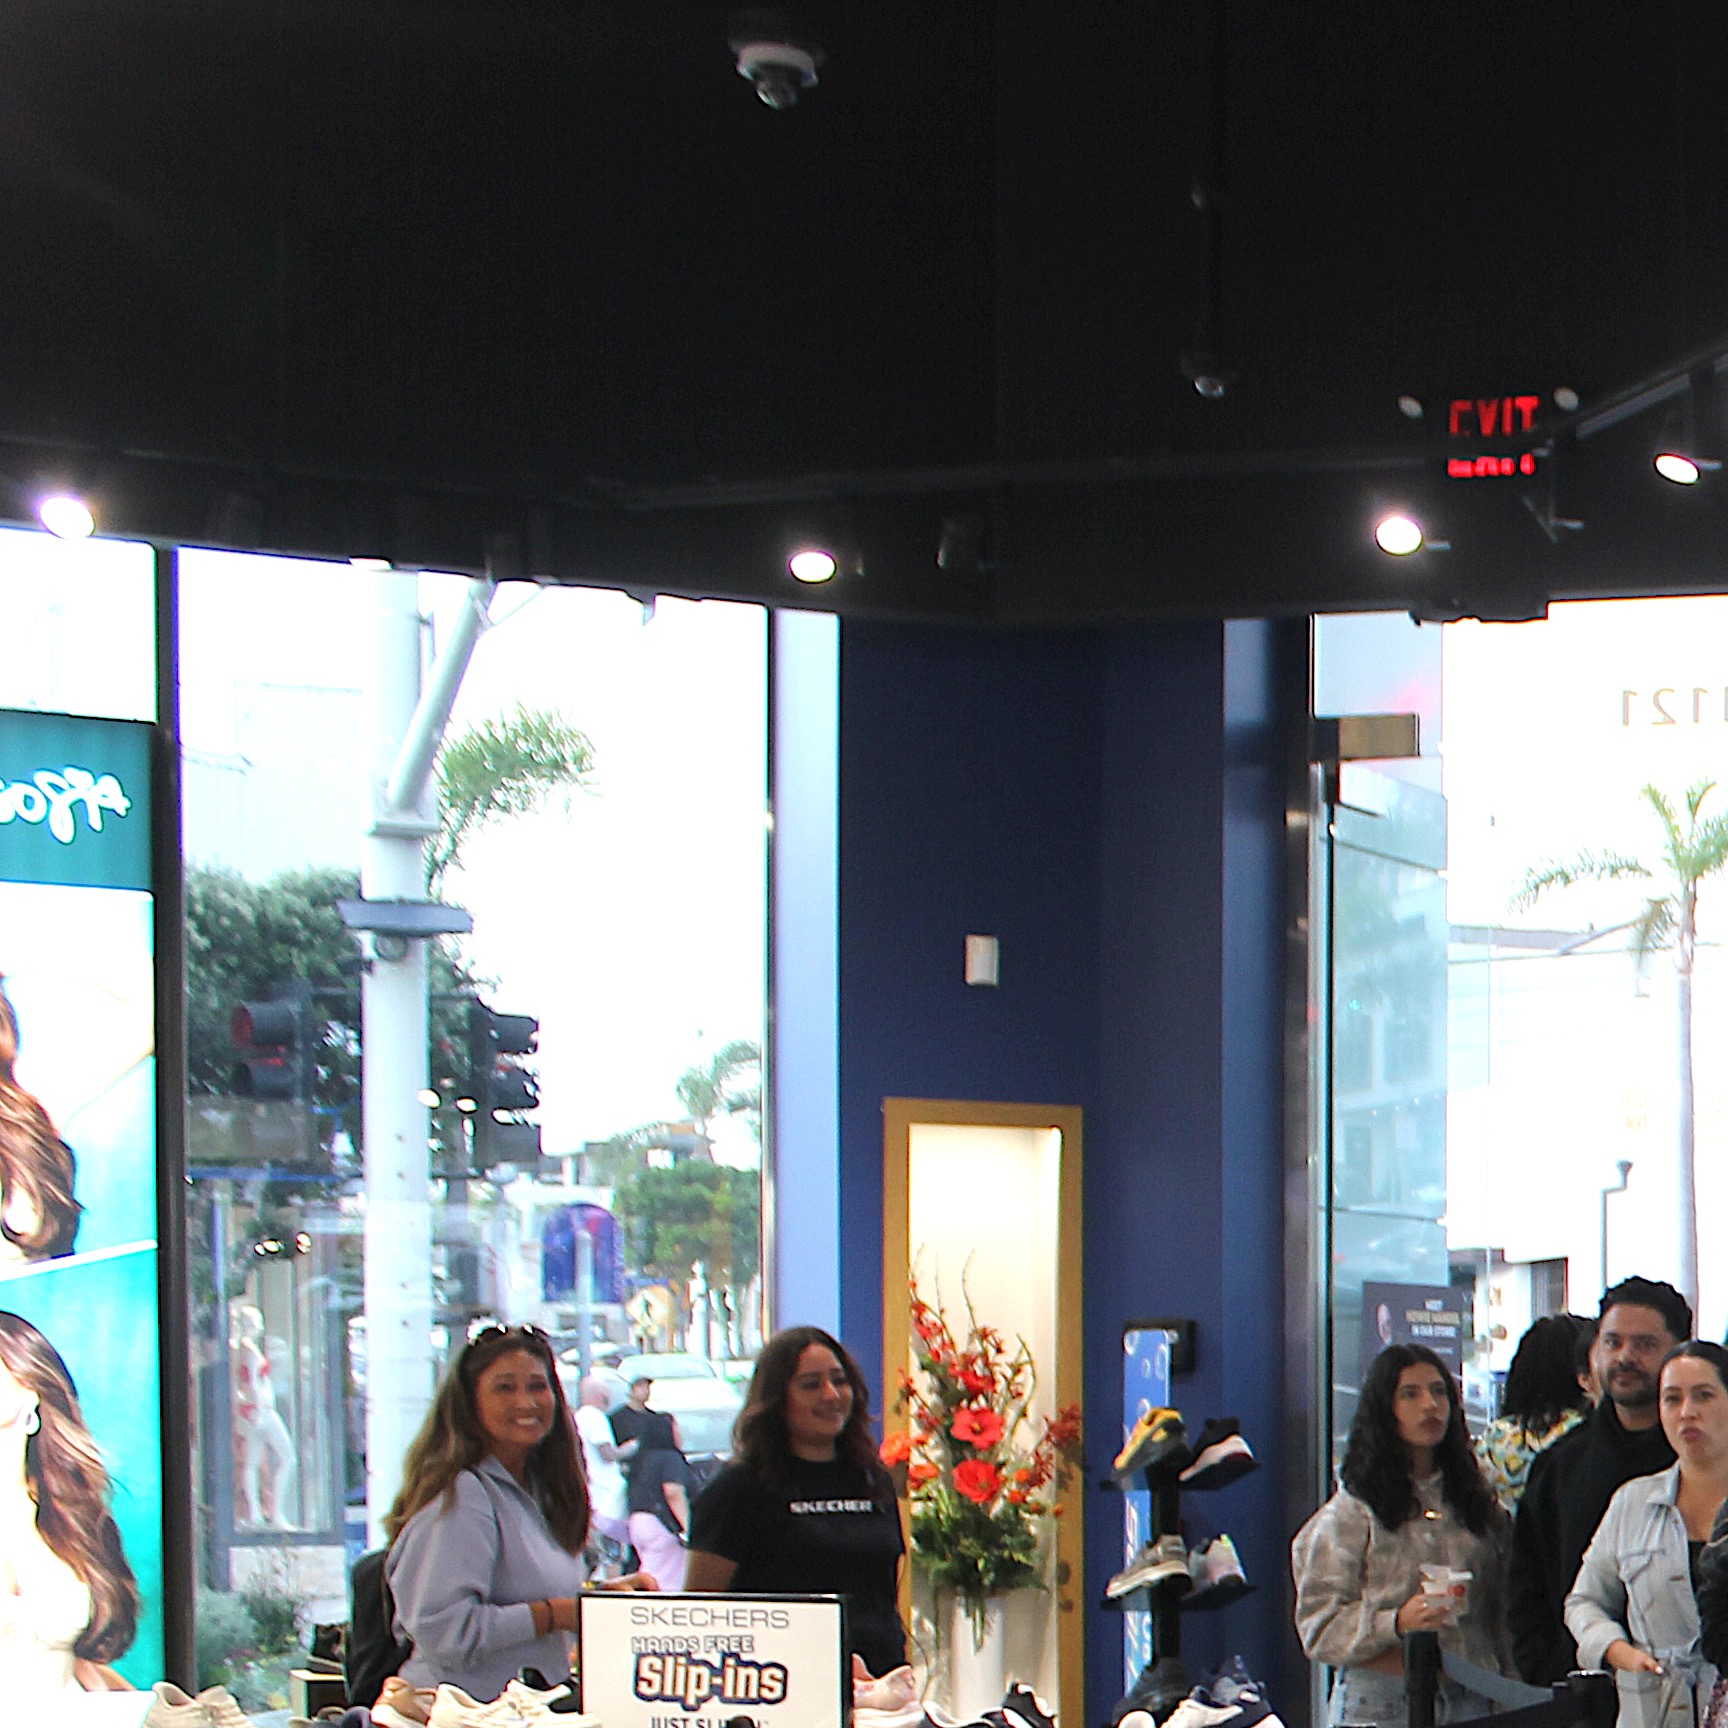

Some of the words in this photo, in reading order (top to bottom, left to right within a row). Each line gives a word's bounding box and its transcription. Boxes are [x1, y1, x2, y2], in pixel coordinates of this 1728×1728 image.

[631, 1606, 789, 1629] SKECHERS
[631, 1636, 699, 1654] HANDS
[703, 1634, 754, 1653] FREE
[635, 1653, 786, 1709] Slip-ins
